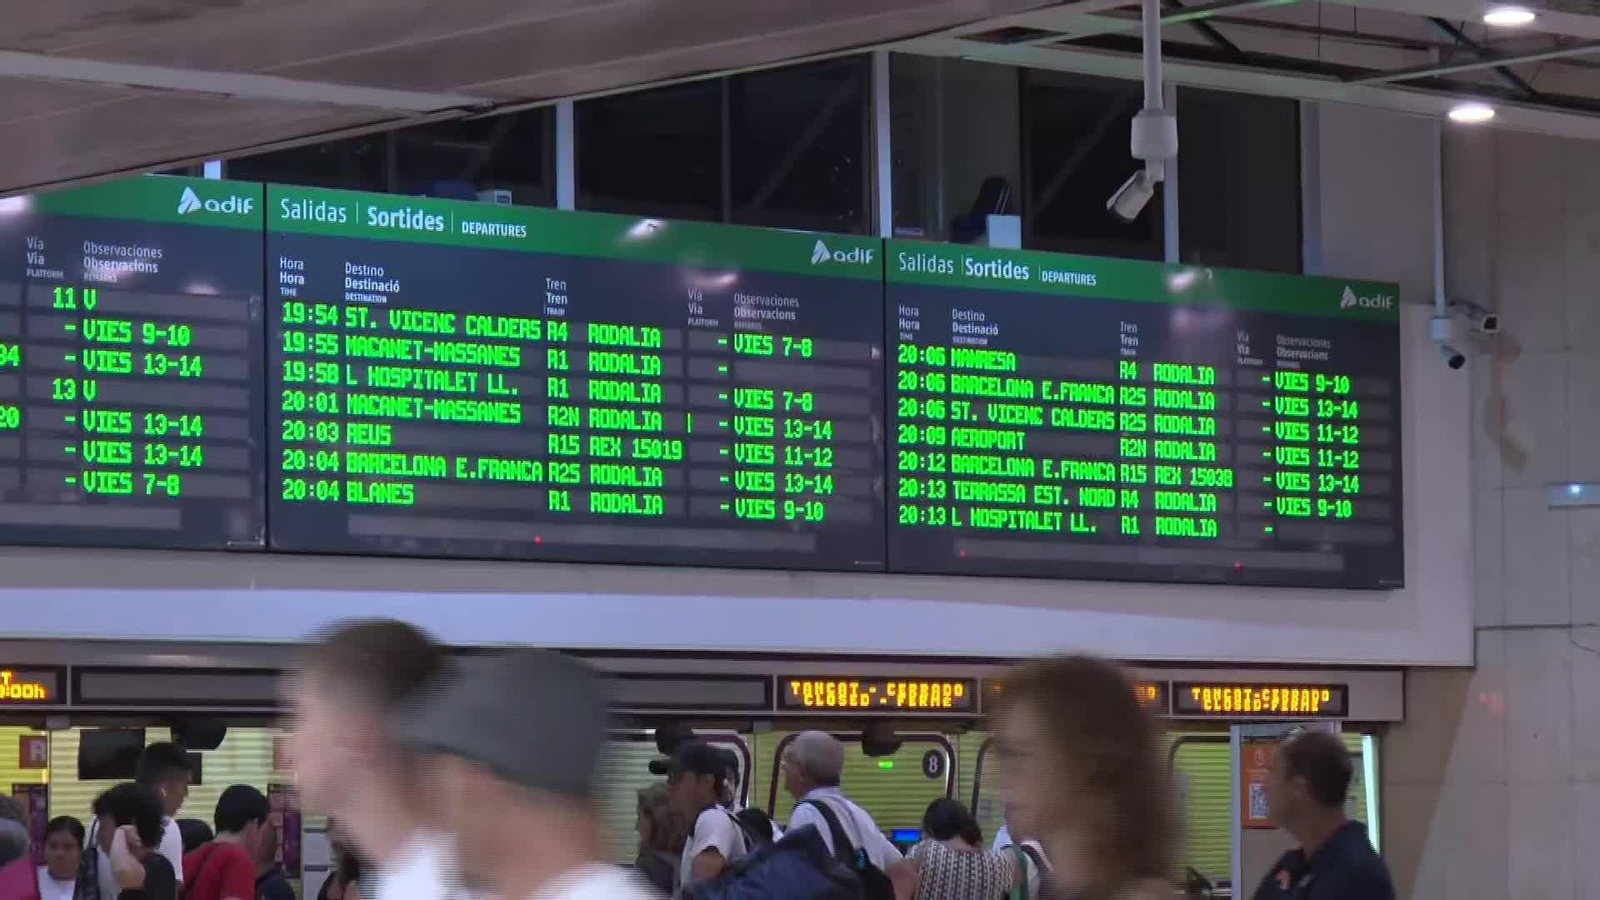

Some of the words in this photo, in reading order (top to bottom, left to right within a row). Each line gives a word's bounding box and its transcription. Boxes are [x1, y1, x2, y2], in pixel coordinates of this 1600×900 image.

[205, 195, 253, 214] adif
[280, 199, 347, 223] Salidas
[367, 206, 444, 231] Sortides
[461, 221, 527, 238] DEPARTURES
[83, 240, 163, 259] Observaciones
[833, 249, 874, 265] adif
[83, 256, 159, 273] Observacions
[280, 257, 304, 270] Hora
[345, 262, 384, 277] Destino
[898, 252, 954, 275] Salidas
[965, 257, 1029, 281] Sortides
[1042, 270, 1097, 287] DEPARTURES
[280, 272, 305, 285] Hora
[345, 277, 400, 293] Destinació
[546, 279, 567, 290] Tren
[55, 287, 76, 309] 11
[84, 289, 96, 309] V
[546, 292, 568, 305] Tren
[734, 292, 800, 307] Observaciones
[734, 306, 796, 320] Observacions
[899, 304, 919, 317] Hora
[952, 308, 985, 322] Destino
[83, 319, 133, 343] VIES
[143, 323, 192, 346] 9-10
[285, 302, 338, 325] 19:54
[346, 307, 377, 327] ST.
[466, 315, 541, 340] CALDERS
[547, 321, 569, 340] R4
[588, 323, 662, 347] RODALIA
[735, 334, 773, 355] VIES
[784, 337, 812, 357] 7-8
[899, 318, 920, 331] Hora
[952, 322, 998, 336] Destinació
[1120, 320, 1138, 334] Tren
[1120, 334, 1139, 347] Tren
[84, 350, 133, 373] VIES
[146, 353, 202, 376] 13-14
[285, 331, 339, 355] 19:55
[548, 349, 569, 370] R1
[589, 351, 662, 375] RODALIA
[899, 344, 946, 366] 20:06
[951, 348, 1016, 371] MANRESA
[1120, 361, 1138, 378] R4
[1154, 364, 1215, 385] RODALIA
[1275, 372, 1309, 391] VIES
[1316, 374, 1350, 394] 9-10
[54, 378, 76, 400] 13
[83, 380, 97, 400] V
[285, 360, 340, 384] 19:58
[347, 364, 357, 385] L
[368, 366, 478, 392] HOSPITALET
[488, 374, 518, 394] LL.
[549, 377, 569, 398] R1
[589, 379, 662, 403] RODALIA
[734, 389, 774, 410] VIES
[785, 391, 813, 412] 7-8
[898, 370, 946, 392] 20:06
[951, 374, 1034, 398] BARCELONA
[1120, 387, 1147, 406] R25
[1154, 389, 1216, 410] RODALIA
[1275, 397, 1309, 416] VIES
[1318, 399, 1358, 419] 13-14
[83, 410, 133, 434] VIES
[146, 413, 203, 436] 13-14
[282, 390, 339, 413] 20:01
[548, 405, 580, 426] R2N
[589, 408, 662, 431] RODALIA
[734, 416, 774, 437] VIES
[785, 419, 832, 439] 13-14
[899, 397, 946, 419] 20:06
[951, 401, 977, 420] ST.
[1052, 407, 1115, 430] CALDERS
[1120, 412, 1147, 431] R25
[1154, 414, 1216, 435] RODALIA
[1275, 422, 1310, 441] VIES
[1318, 424, 1358, 444] 11-12
[83, 441, 133, 464] VIES
[146, 444, 203, 466] 13-14
[283, 420, 340, 442] 20:03
[347, 422, 393, 446] REUS
[549, 434, 580, 455] R15
[590, 436, 622, 456] REX
[634, 439, 682, 460] 15019
[735, 444, 775, 464] VIES
[786, 447, 832, 467] 11-12
[899, 424, 946, 445] 20:09
[951, 428, 1025, 449] AEROPORT
[1120, 438, 1147, 457] R2N
[1154, 440, 1216, 461] RODALIA
[1276, 447, 1310, 466] VIES
[1319, 449, 1359, 469] 11-12
[283, 449, 340, 471] 20:04
[346, 451, 447, 476] BARCELONA
[549, 462, 580, 483] R25
[590, 464, 664, 486] RODALIA
[735, 471, 775, 492] VIES
[786, 474, 833, 494] 13-14
[899, 451, 946, 473] 20:12
[951, 454, 1035, 476] BARCELONA
[1120, 464, 1147, 483] R15
[1155, 466, 1182, 485] REX
[1192, 467, 1233, 487] 15038
[1276, 472, 1310, 491] VIES
[1319, 474, 1359, 493] 13-14
[83, 471, 133, 494] VIES
[146, 474, 180, 495] 7-8
[283, 479, 340, 500] 20:04
[347, 481, 414, 505] BLANES
[549, 490, 570, 511] R1
[591, 492, 663, 515] RODALIA
[735, 499, 776, 519] VIES
[784, 500, 824, 520] 9-10
[899, 478, 946, 499] 20:13
[954, 481, 1026, 503] TERRASSA
[1034, 485, 1068, 505] EST.
[1079, 487, 1115, 507] NORD
[1121, 489, 1139, 507] R4
[1155, 491, 1216, 512] RODALIA
[1277, 497, 1311, 516] VIES
[1318, 499, 1352, 518] 9-10
[900, 505, 947, 525] 20:13
[952, 507, 961, 526] L
[970, 508, 1062, 531] HOSPITALET
[1071, 514, 1095, 533] LL.
[1121, 516, 1139, 534] R1
[1156, 517, 1217, 537] RODALIA
[804, 694, 870, 707] CLOSED
[928, 756, 938, 774] 8
